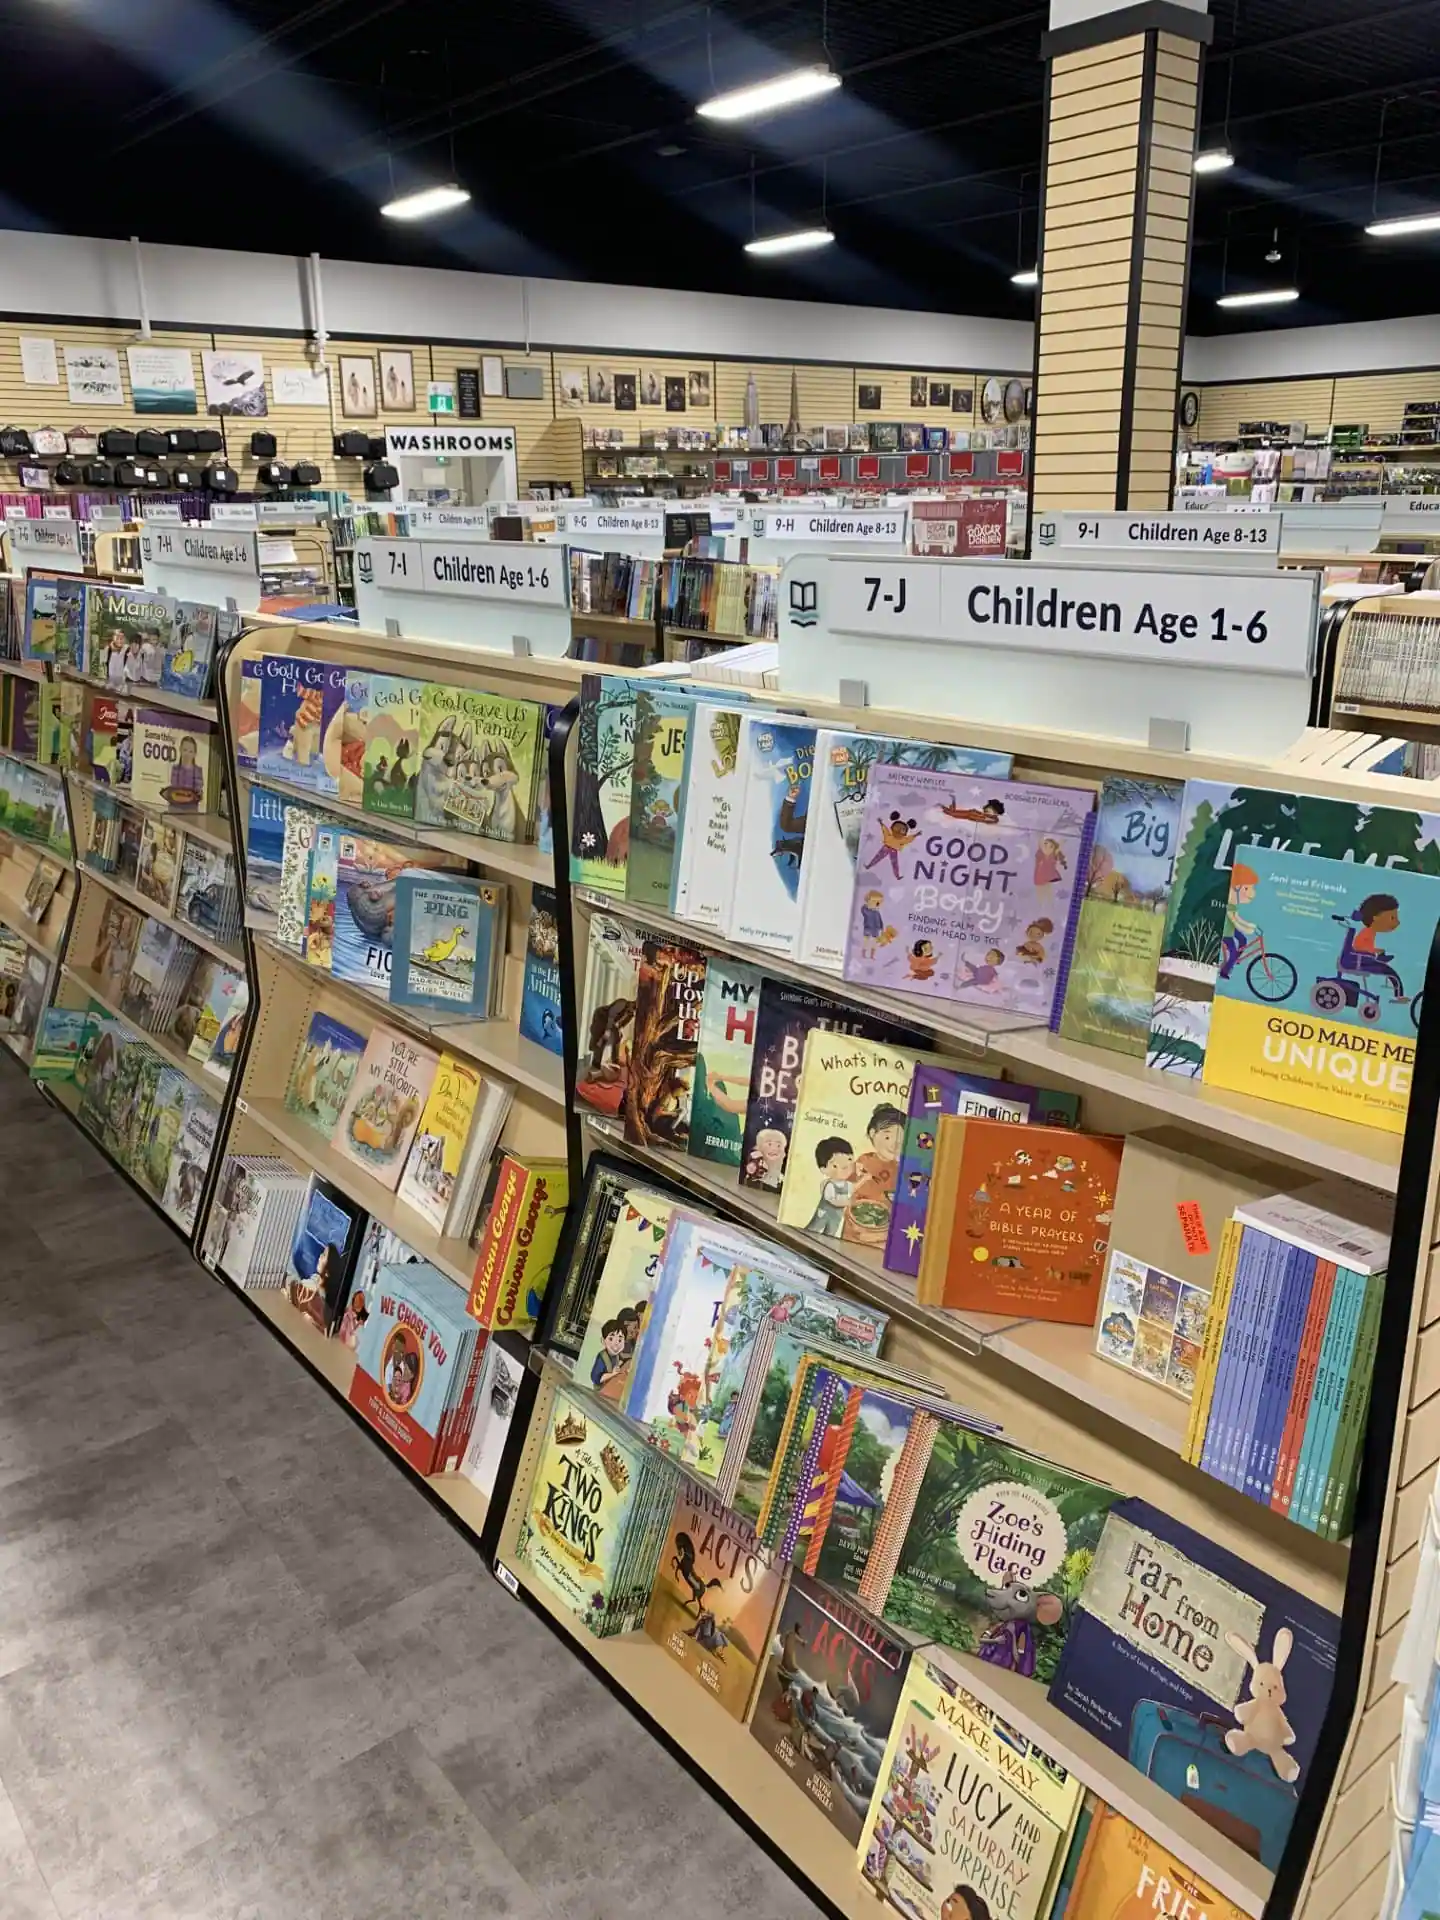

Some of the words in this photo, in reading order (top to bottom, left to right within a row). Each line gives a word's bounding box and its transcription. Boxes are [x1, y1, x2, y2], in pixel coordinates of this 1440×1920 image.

[390, 435, 513, 450] WASHROOMS
[574, 516, 587, 528] 9-G
[597, 515, 629, 528] Children
[631, 519, 643, 530] Age
[644, 519, 658, 529] 8-13
[775, 518, 794, 532] 9-H
[809, 518, 854, 533] Children
[856, 524, 874, 536] Age
[875, 522, 896, 533] 8-13
[1078, 522, 1099, 539] 9-I
[1128, 522, 1198, 542] Children
[1203, 528, 1230, 544] Age
[1233, 528, 1267, 544] 8-13
[157, 535, 172, 553] 7-H
[184, 541, 218, 560] Children
[220, 545, 234, 563] Age
[236, 544, 248, 562] 1-6
[388, 551, 407, 576] 7-I
[433, 556, 495, 585] Children
[499, 564, 523, 590] Age
[527, 566, 549, 589] 1-6
[108, 595, 166, 619] Mario
[863, 576, 908, 613] 7-J
[967, 584, 1122, 633] Children
[1134, 602, 1199, 644] Age
[1209, 607, 1268, 644] 1-6
[375, 687, 405, 705] God
[433, 690, 461, 712] God
[462, 697, 503, 720] Gave
[505, 699, 528, 722] Us
[474, 717, 528, 748] Family
[143, 742, 177, 763] GOOD
[1122, 810, 1169, 858] Big
[925, 835, 1009, 865] GOOD
[1268, 872, 1289, 885] Joni
[1291, 877, 1309, 887] and
[1311, 879, 1347, 895] Friends
[423, 900, 470, 920] PING
[908, 913, 947, 928] FINDING
[950, 920, 975, 931] CALM
[913, 884, 1006, 934] Body
[912, 924, 938, 936] FROM
[942, 929, 967, 941] HEAD
[970, 935, 981, 943] TO
[984, 936, 1001, 947] TOE
[673, 962, 699, 988] Up
[721, 979, 755, 1004] MY
[391, 1040, 420, 1067] YOU'RE
[1267, 1017, 1314, 1041] GOD
[1317, 1027, 1379, 1056] MADE
[1381, 1042, 1416, 1065] ME
[388, 1057, 408, 1078] STILL
[820, 1051, 866, 1072] What's
[873, 1052, 887, 1067] in
[894, 1059, 906, 1070] a
[1263, 1035, 1413, 1095] UNIQUE
[370, 1063, 381, 1077] MY
[383, 1071, 420, 1097] FAVORITE
[1281, 1073, 1314, 1088] Children
[803, 1111, 831, 1127] Sandra
[964, 1100, 1022, 1124] Finding
[999, 1202, 1011, 1214] A
[1016, 1205, 1052, 1220] YEAR
[1060, 1210, 1079, 1222] OF
[472, 1240, 499, 1317] Curious
[492, 1168, 517, 1240] George
[989, 1220, 1023, 1235] BIBLE
[1031, 1226, 1085, 1244] PRAYERS
[496, 1249, 529, 1326] Curious
[516, 1176, 549, 1248] George
[380, 1295, 396, 1317] WE
[397, 1303, 428, 1341] CHOSE
[428, 1328, 448, 1367] YOU
[558, 1453, 603, 1515] TWO
[542, 1481, 604, 1563] KINGS
[686, 1485, 776, 1570] ADVENTURES
[987, 1500, 1044, 1536] Zoe's
[690, 1514, 702, 1536] IN
[699, 1523, 758, 1594] ACTS
[970, 1519, 1046, 1567] Hiding
[907, 1565, 926, 1579] DAVID
[973, 1542, 1032, 1581] Place
[1124, 1540, 1182, 1601] Far
[1175, 1593, 1220, 1640] from
[1118, 1582, 1214, 1673] Home
[811, 1620, 875, 1703] ACTS
[1118, 1643, 1130, 1660] Story
[936, 1696, 993, 1753] MAKE
[997, 1743, 1040, 1792] WAY
[943, 1752, 1013, 1830] LUCY
[1014, 1813, 1041, 1845] AND
[949, 1805, 1030, 1887] SATURDAY
[1010, 1834, 1035, 1865] THE
[939, 1829, 1022, 1920] SURPRISE
[1182, 1880, 1198, 1897] THE
[1136, 1863, 1208, 1920] FRIE
